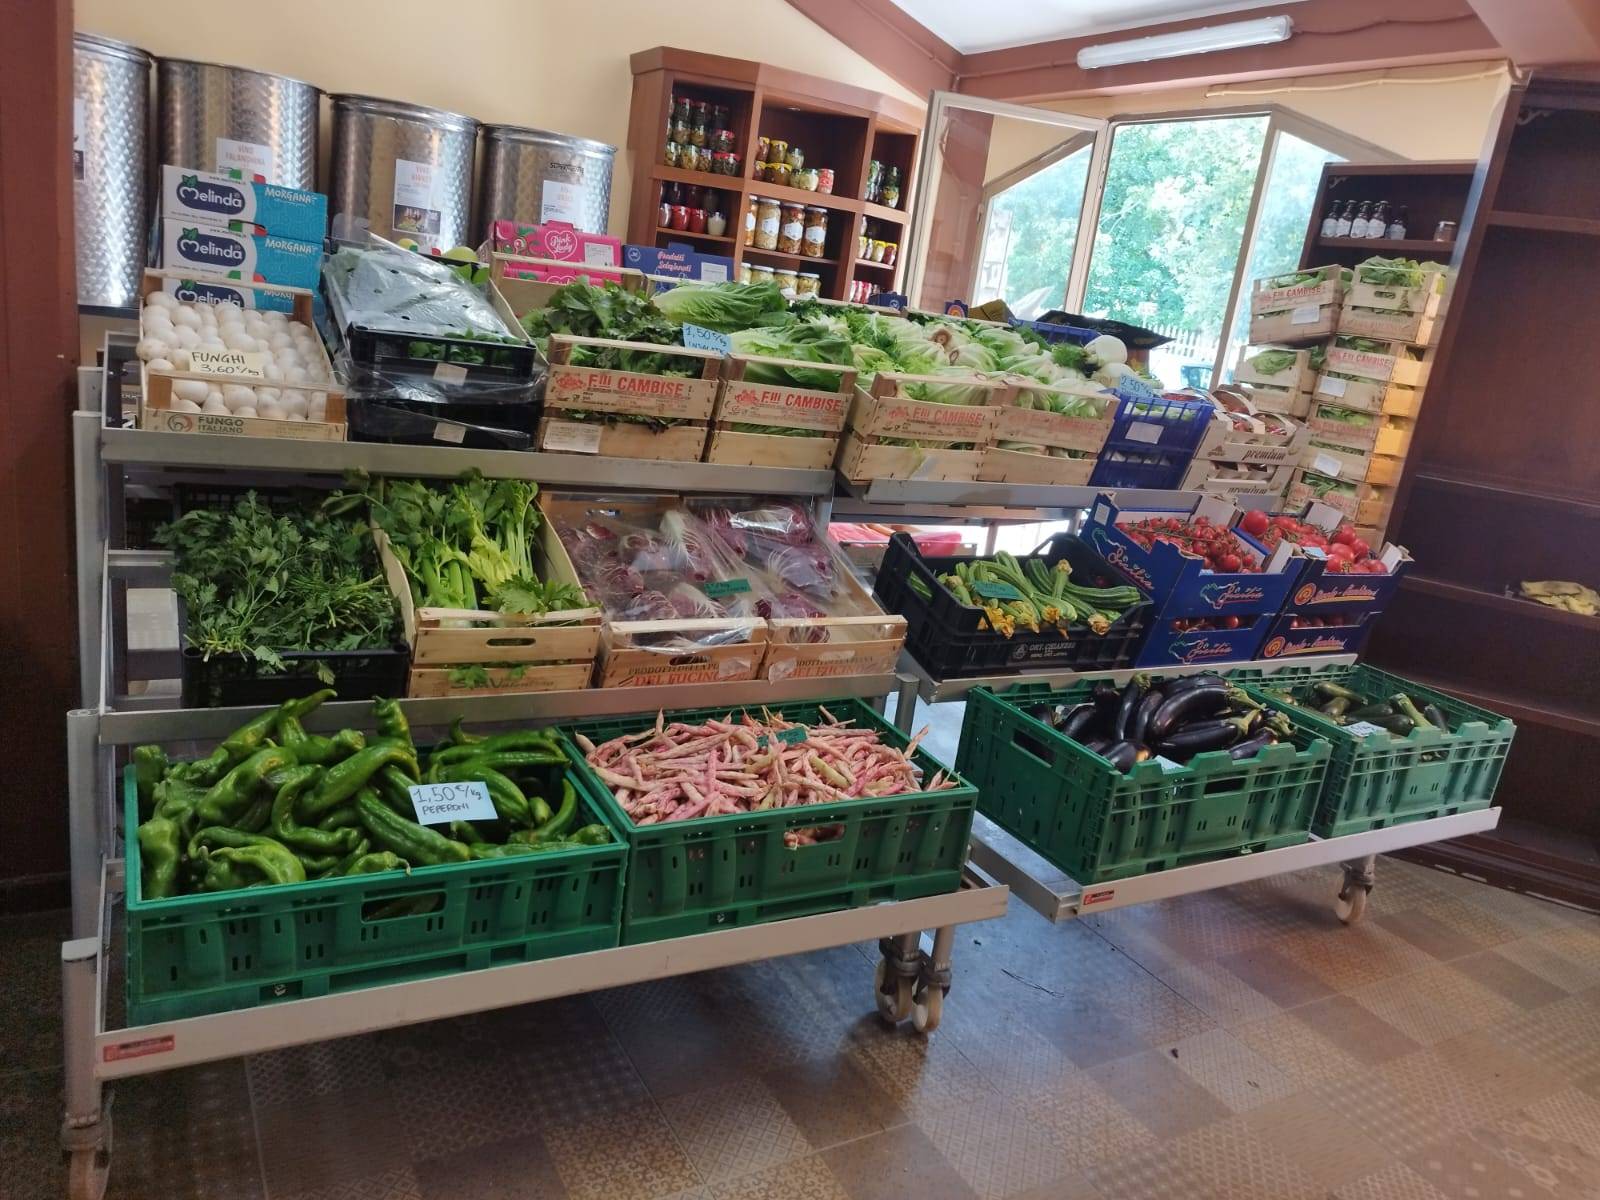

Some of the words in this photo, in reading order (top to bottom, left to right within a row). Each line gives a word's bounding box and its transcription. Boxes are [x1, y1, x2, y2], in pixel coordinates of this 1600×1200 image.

[180, 187, 242, 208] Melinda
[550, 233, 571, 247] Pink
[181, 239, 242, 260] Melinda
[192, 352, 245, 364] FUNGHI
[618, 376, 684, 397] CAMBISE
[785, 393, 842, 411] CAMBISE
[198, 416, 244, 427] FUNGO
[934, 409, 983, 426] CAMBISE
[198, 425, 243, 434] ITALIANO
[1241, 449, 1286, 461] premium
[634, 674, 664, 687] DEL
[422, 803, 469, 815] PEPERONI
